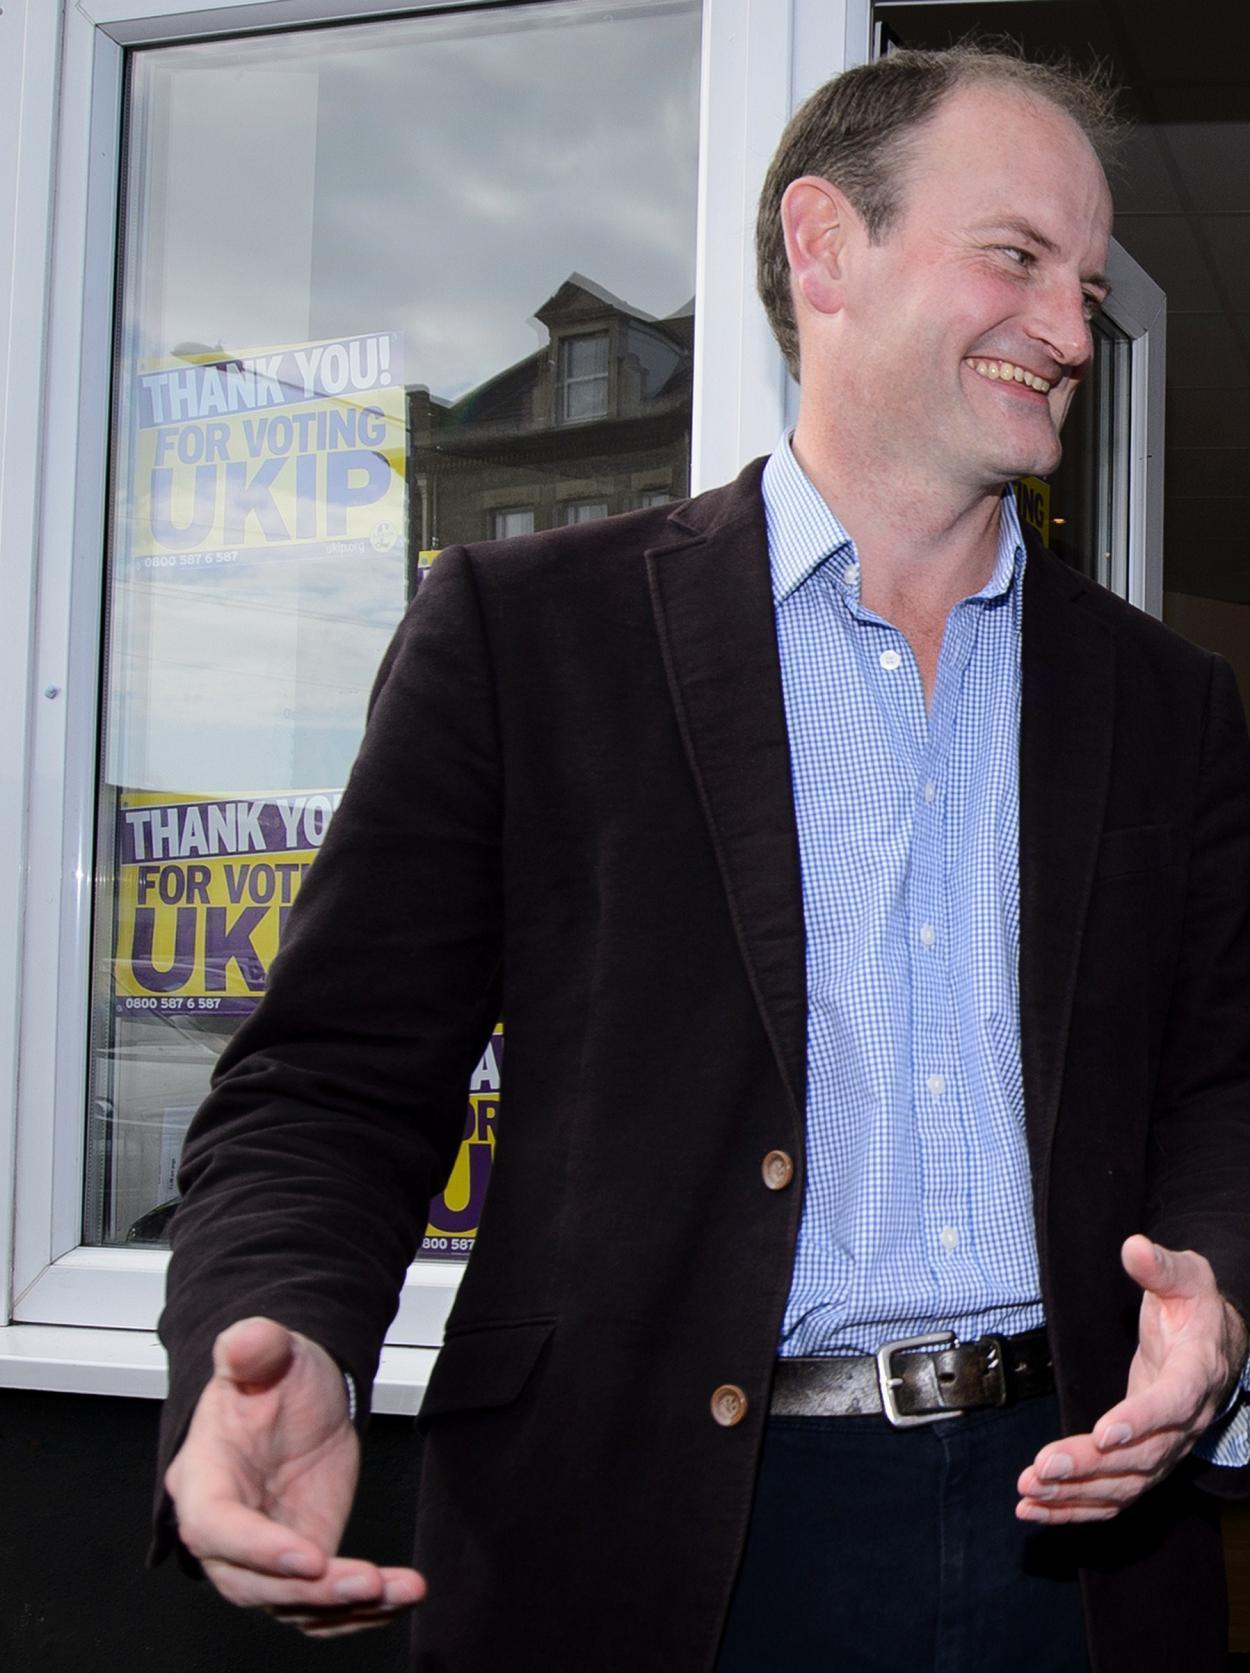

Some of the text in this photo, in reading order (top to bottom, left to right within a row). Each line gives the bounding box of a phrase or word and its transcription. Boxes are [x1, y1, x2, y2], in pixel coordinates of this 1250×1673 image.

[143, 335, 392, 424] THANK YOU!
[154, 406, 386, 466] FOR VOTING
[151, 451, 392, 550] UKIP
[144, 551, 238, 568] 0800 587 6 587
[126, 795, 341, 860] THANK YO
[137, 864, 211, 905] FOR
[131, 905, 296, 993] UK
[125, 998, 221, 1009] 0800 587 6 587
[450, 1238, 475, 1251] 587
